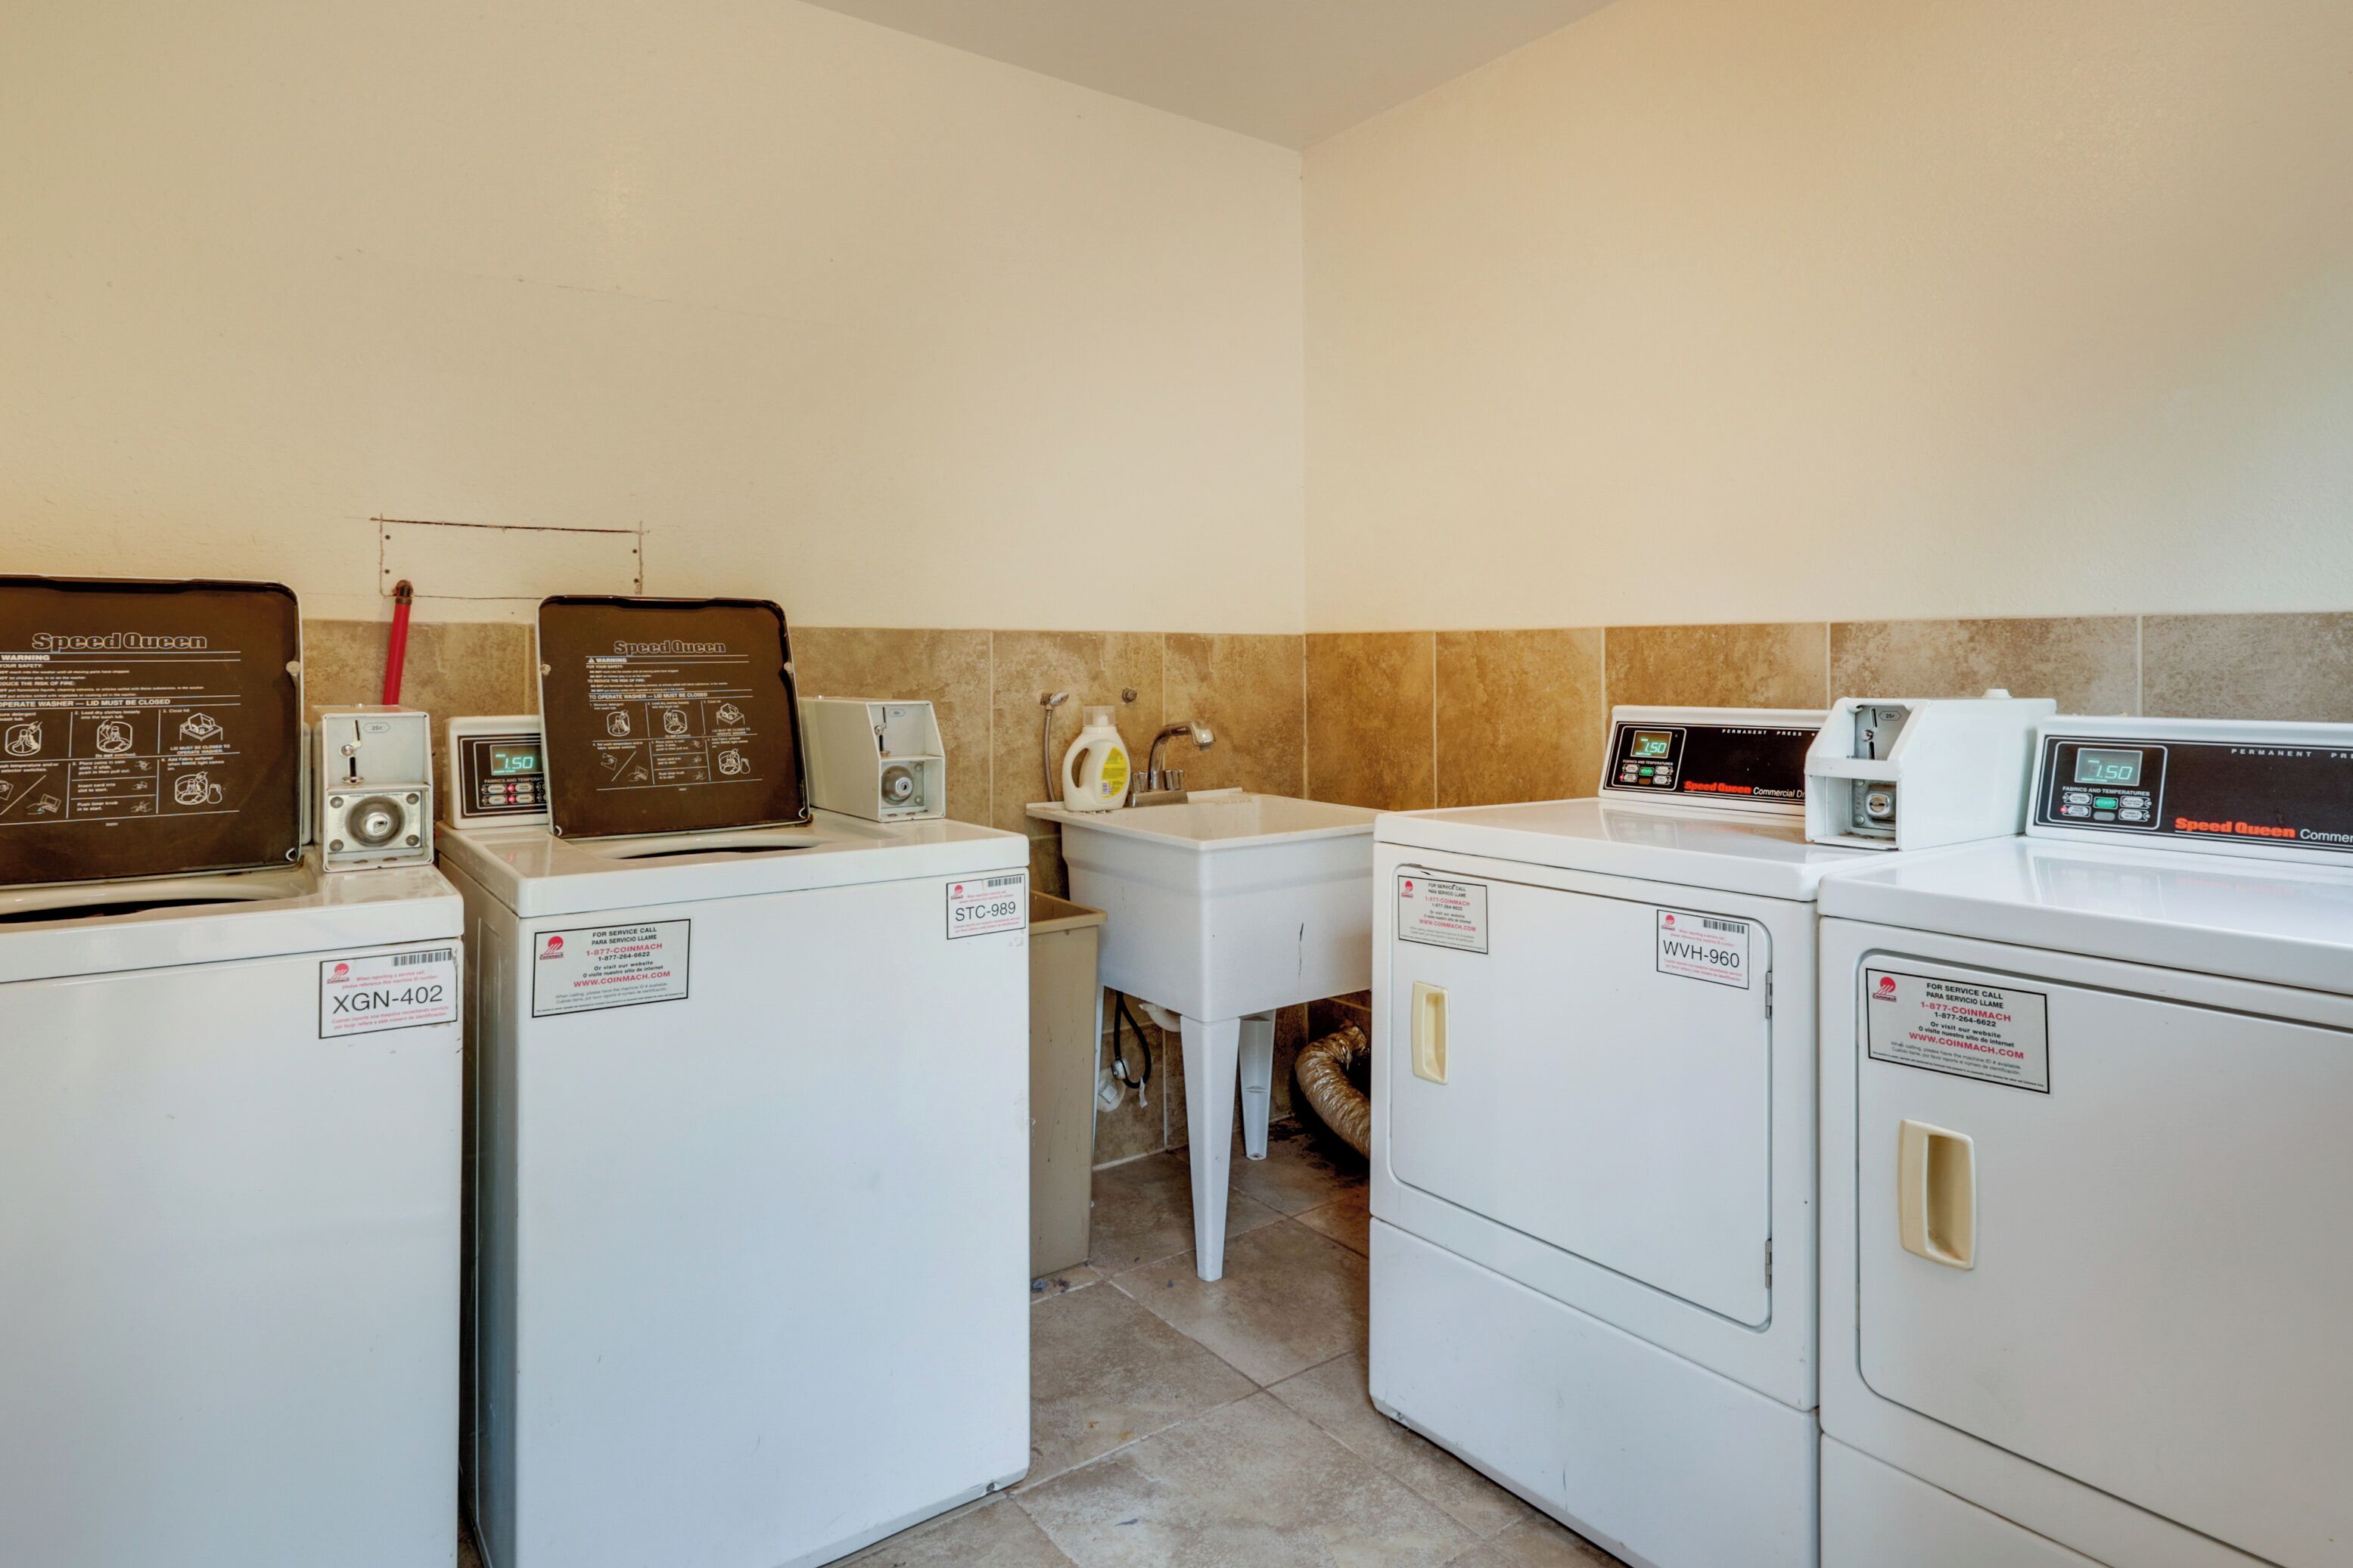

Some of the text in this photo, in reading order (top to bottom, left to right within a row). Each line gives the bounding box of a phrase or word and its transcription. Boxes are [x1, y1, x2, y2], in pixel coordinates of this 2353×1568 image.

[32, 632, 207, 653] Speed Queen
[614, 640, 726, 656] Speed Queen
[2231, 748, 2312, 757] PERMANENT
[1684, 781, 1717, 792] Speed
[1718, 782, 1752, 794] Queen
[1753, 787, 1795, 798] Commercial
[2175, 817, 2233, 832] Speed
[2234, 822, 2295, 838] Queen
[955, 901, 1016, 922] STC-989
[586, 943, 663, 956] 1-877-COINMACH
[598, 952, 650, 961] 1-877-264-6622
[1663, 939, 1739, 968] WVH-960
[573, 971, 670, 987] WWW.COINMACH.COM
[333, 985, 442, 1014] XGN-402
[1945, 985, 1980, 996] SERVICE
[1982, 991, 2003, 1000] CALL
[1946, 994, 1977, 1004] SERVICIO
[1980, 1000, 2004, 1009] LLAME
[1921, 1001, 2011, 1022] 1-877-COINMACH
[1935, 1012, 1996, 1027] 1-877-264-6622
[1942, 1030, 1964, 1039] nuestro
[1990, 1039, 2014, 1048] internet
[1972, 1029, 2001, 1039] website
[1909, 1032, 2024, 1059] WWW.COINMACH.COM
